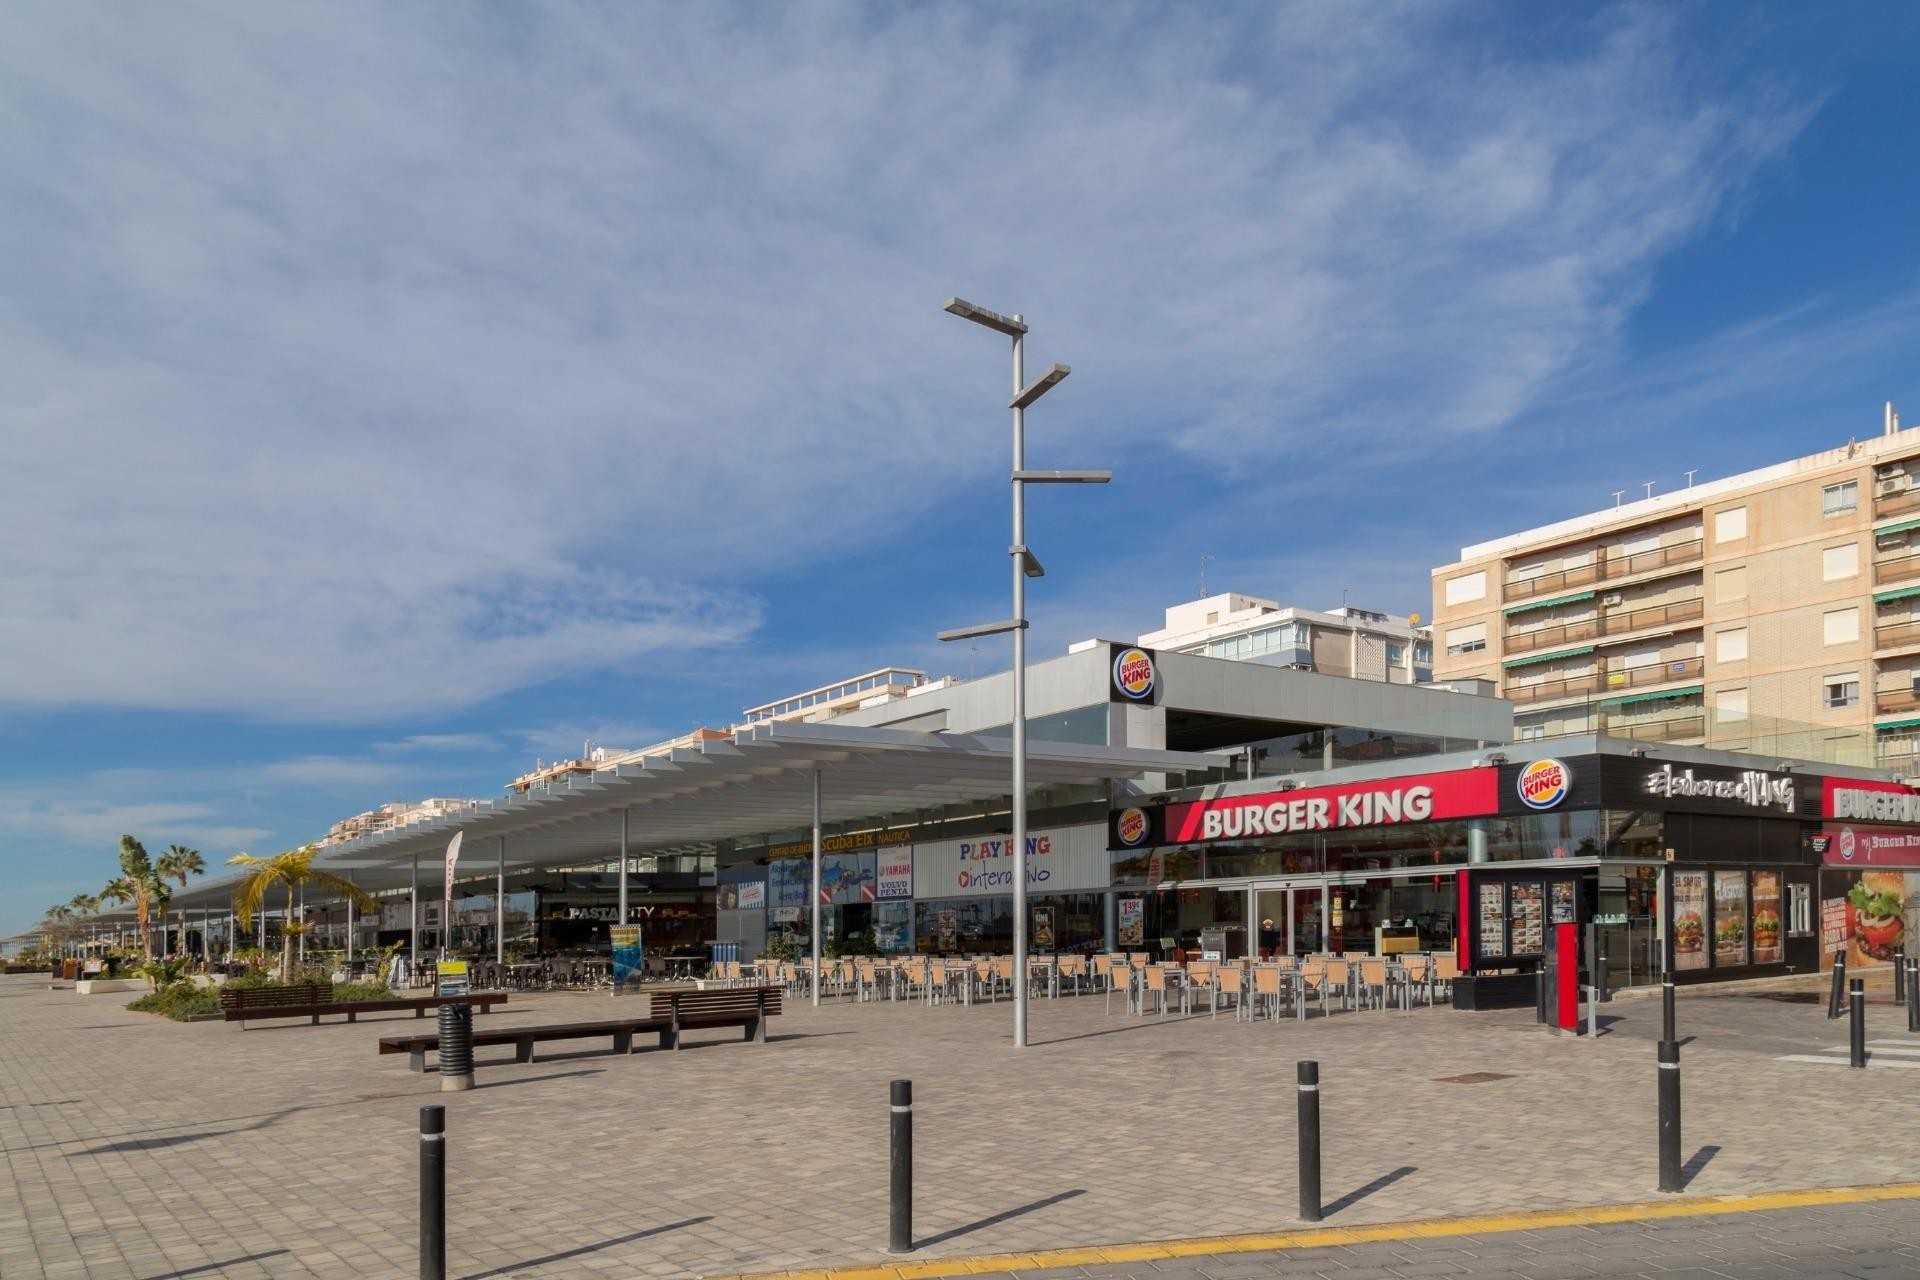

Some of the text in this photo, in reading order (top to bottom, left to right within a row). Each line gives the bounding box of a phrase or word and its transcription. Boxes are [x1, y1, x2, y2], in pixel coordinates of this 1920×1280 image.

[1122, 659, 1149, 674] BURGER
[1123, 667, 1151, 687] KING
[1523, 766, 1560, 787] BURGER
[1525, 774, 1562, 798] KING
[1203, 785, 1433, 840] BURGER KING
[1834, 788, 1904, 821] BURGER
[1122, 819, 1143, 837] KING
[821, 836, 853, 851] Scuba
[960, 836, 1051, 860] PLAY KNG
[886, 864, 911, 877] YAMAHA
[880, 888, 909, 896] PENTA
[569, 907, 619, 921] PASTA
